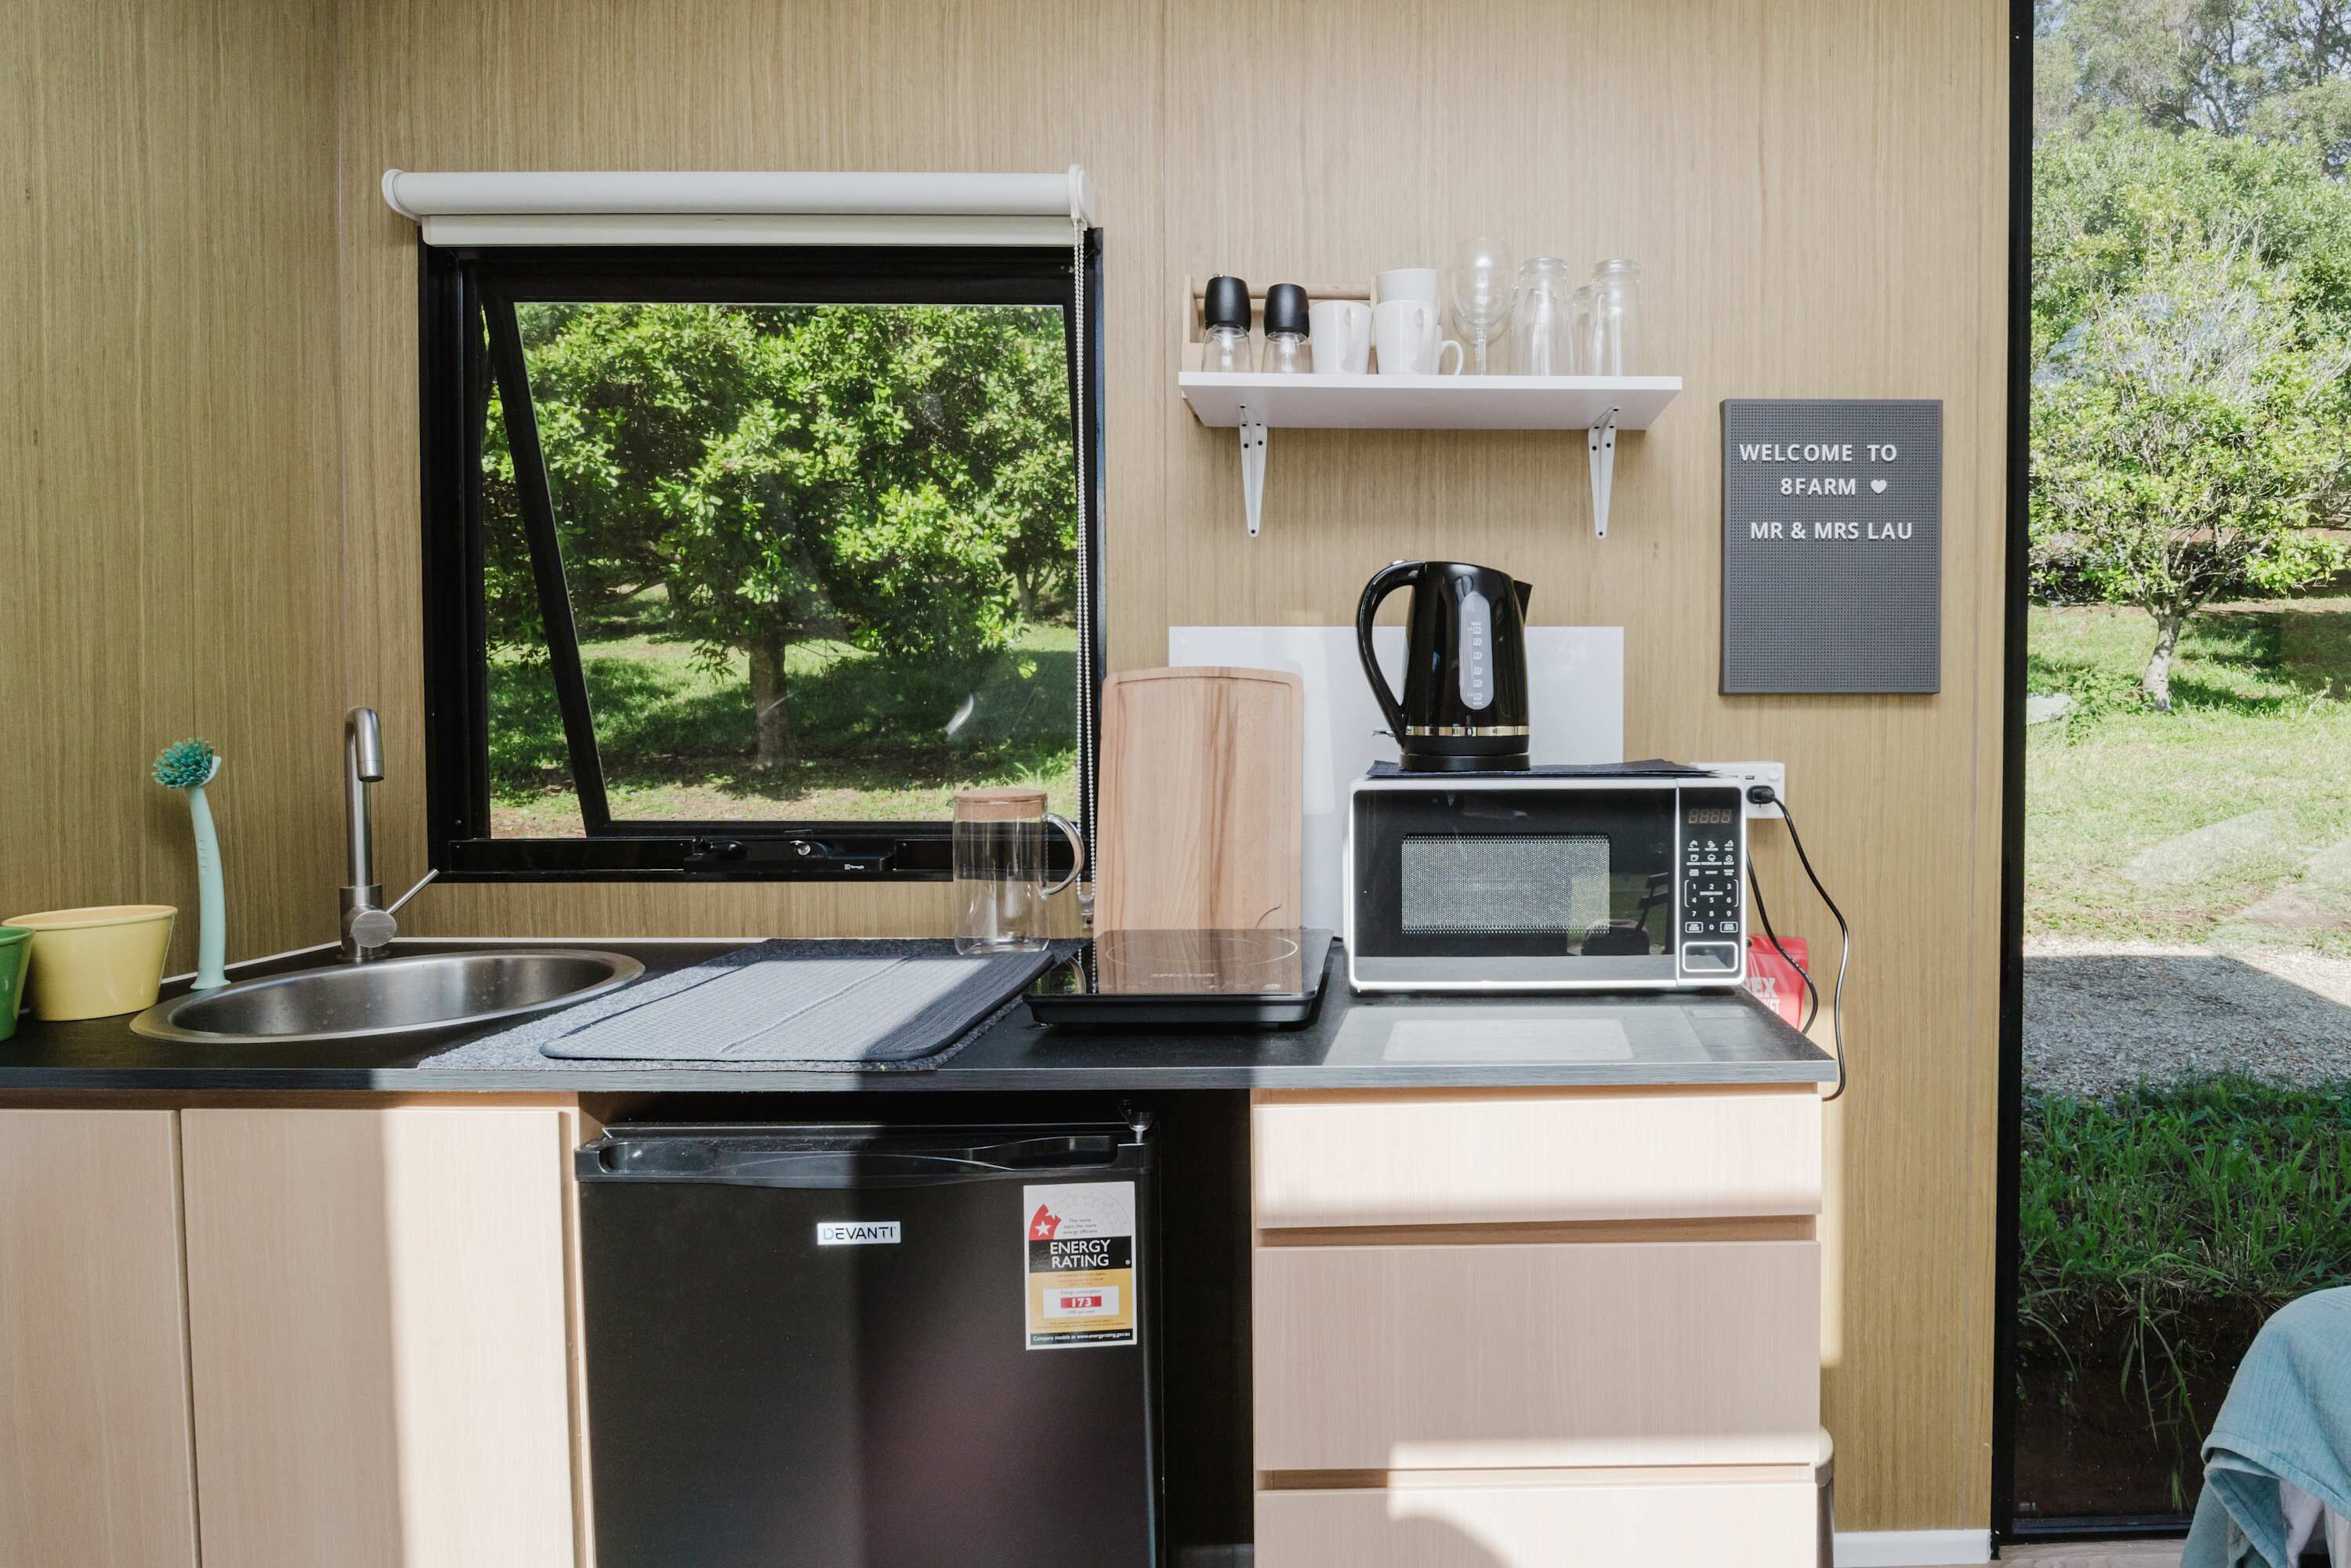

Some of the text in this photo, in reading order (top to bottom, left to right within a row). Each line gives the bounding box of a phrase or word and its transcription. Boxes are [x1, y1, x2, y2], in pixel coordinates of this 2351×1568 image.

[1739, 444, 1897, 462] WELCOME TO
[1780, 477, 1856, 495] 8FARM
[1751, 521, 1912, 540] MR & MRS LAU
[824, 1226, 893, 1240] DEVANTI
[1050, 1239, 1111, 1255] ENERGY
[1052, 1254, 1109, 1268] RATING
[1071, 1297, 1092, 1307] 173
